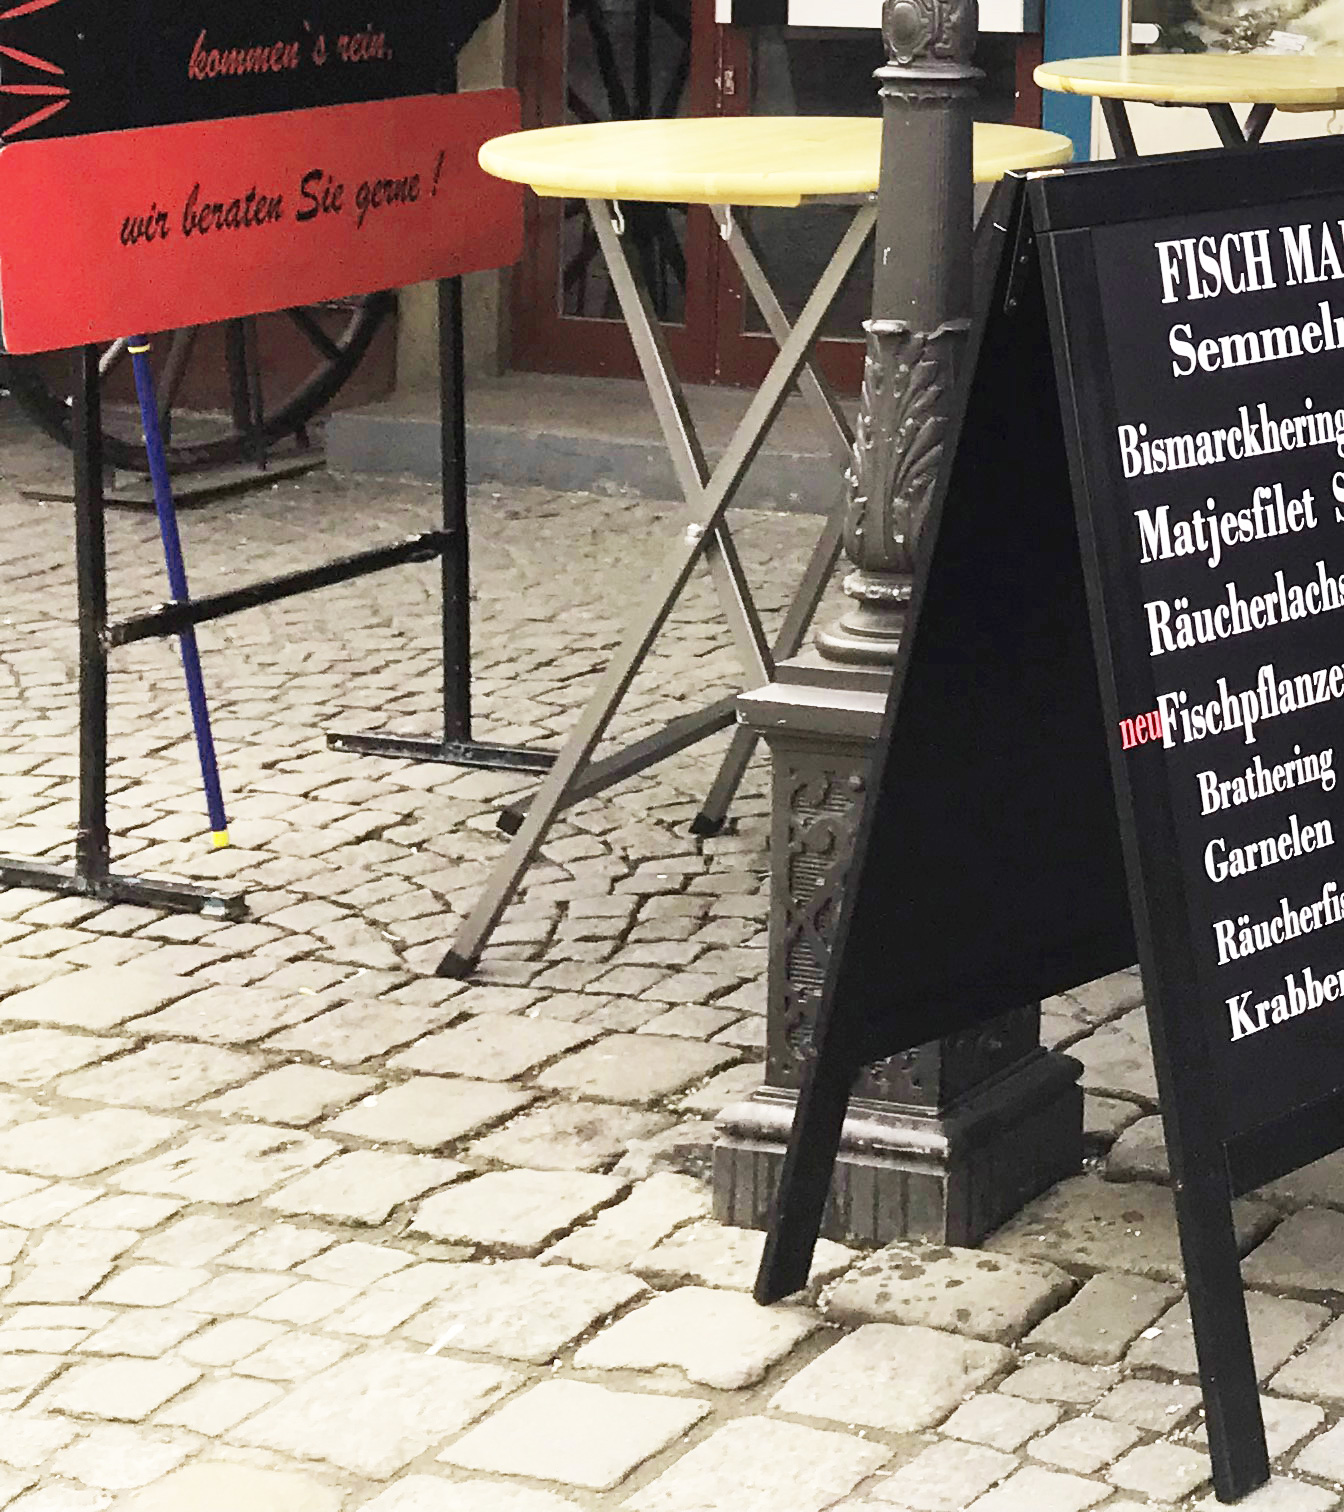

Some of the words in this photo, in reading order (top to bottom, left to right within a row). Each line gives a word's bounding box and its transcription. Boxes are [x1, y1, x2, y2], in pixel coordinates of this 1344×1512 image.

[120, 203, 170, 245] wir
[182, 183, 283, 238] beraten
[295, 169, 346, 222] Sie
[1155, 229, 1277, 304] FISCH
[1134, 484, 1318, 569] Matjesfilet
[1119, 709, 1162, 750] neu
[1197, 744, 1336, 816] Brathering
[1204, 814, 1335, 883] Garnelen
